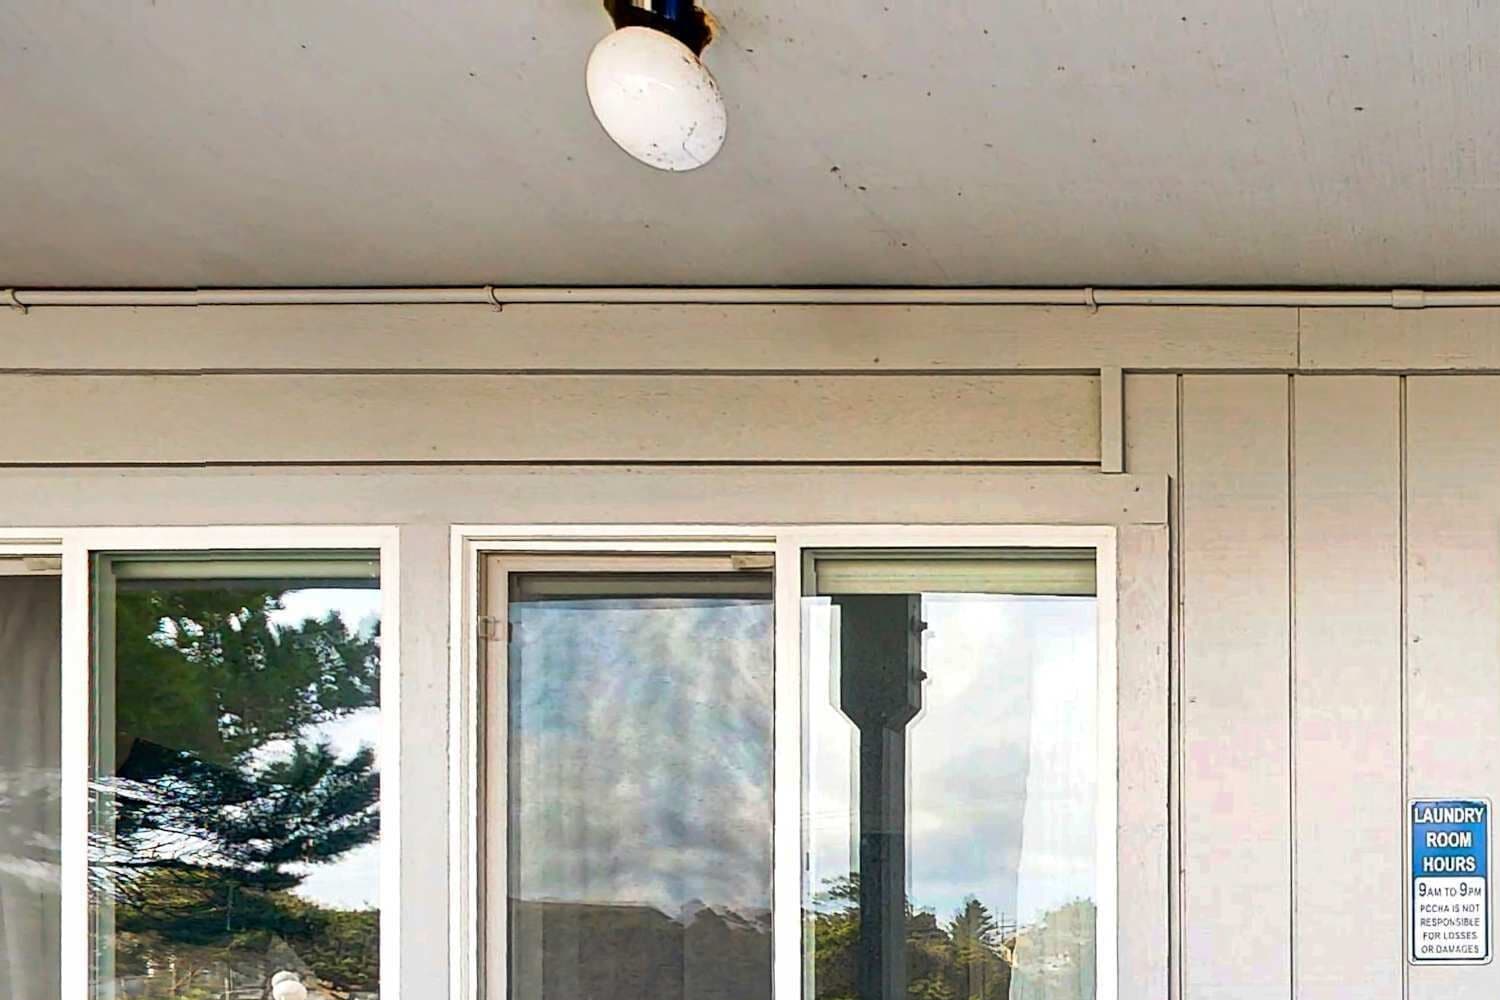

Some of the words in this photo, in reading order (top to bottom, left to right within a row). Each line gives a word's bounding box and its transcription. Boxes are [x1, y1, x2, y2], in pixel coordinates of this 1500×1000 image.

[1414, 807, 1484, 824] LAUNDRY
[1426, 832, 1472, 847] ROOM
[1423, 856, 1476, 872] HOURS
[1444, 887, 1457, 897] TO
[1452, 903, 1460, 913] IS
[1462, 903, 1480, 913] NOT
[1420, 917, 1480, 927] RESPONSIBLE
[1423, 931, 1441, 941] FOR
[1443, 931, 1478, 940] LOSSES
[1420, 944, 1434, 954] OR
[1436, 944, 1479, 954] DAMAGES
